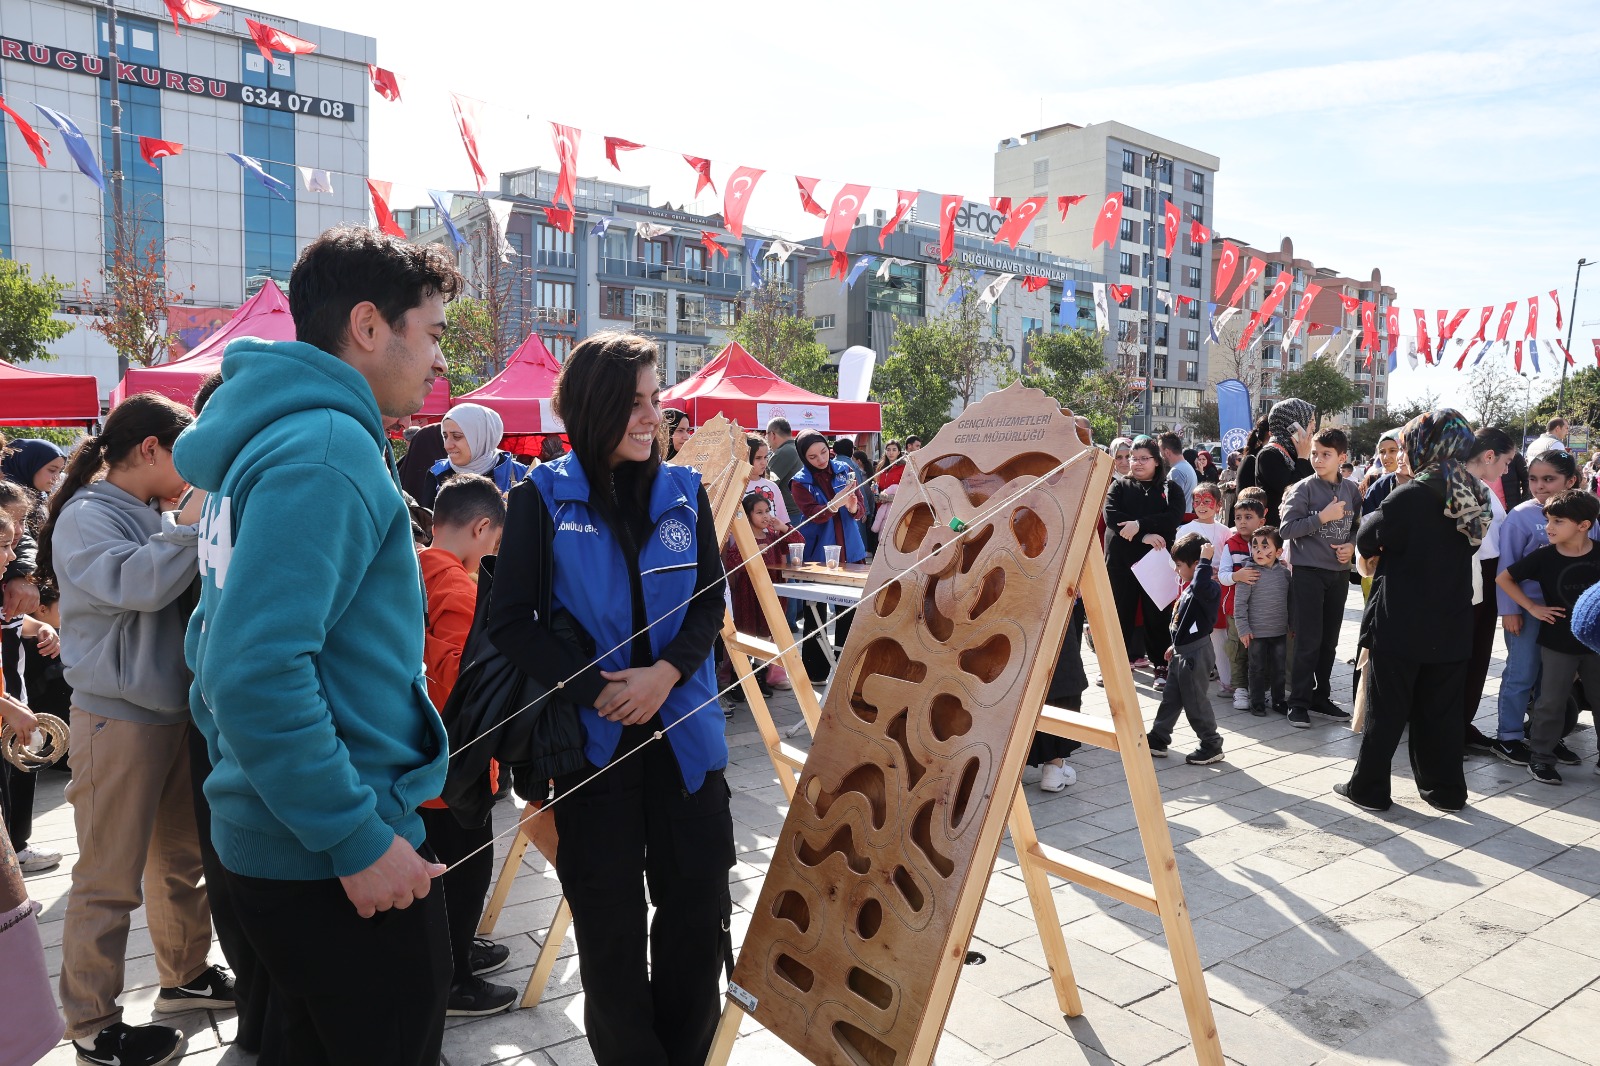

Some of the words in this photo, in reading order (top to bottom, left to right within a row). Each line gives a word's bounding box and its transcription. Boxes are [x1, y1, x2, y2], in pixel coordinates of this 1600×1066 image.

[1, 39, 103, 75] RÜCÜ
[117, 62, 227, 97] KURSU
[241, 85, 281, 108] 634
[288, 94, 313, 113] 07
[319, 100, 344, 119] 08
[995, 260, 1023, 273] DAVET
[957, 416, 995, 430] GENÇLİK
[996, 412, 1053, 428] HİZMETLERİ
[954, 433, 982, 444] GENEL
[983, 428, 1046, 443] MÜDÜRLÜĞÜ
